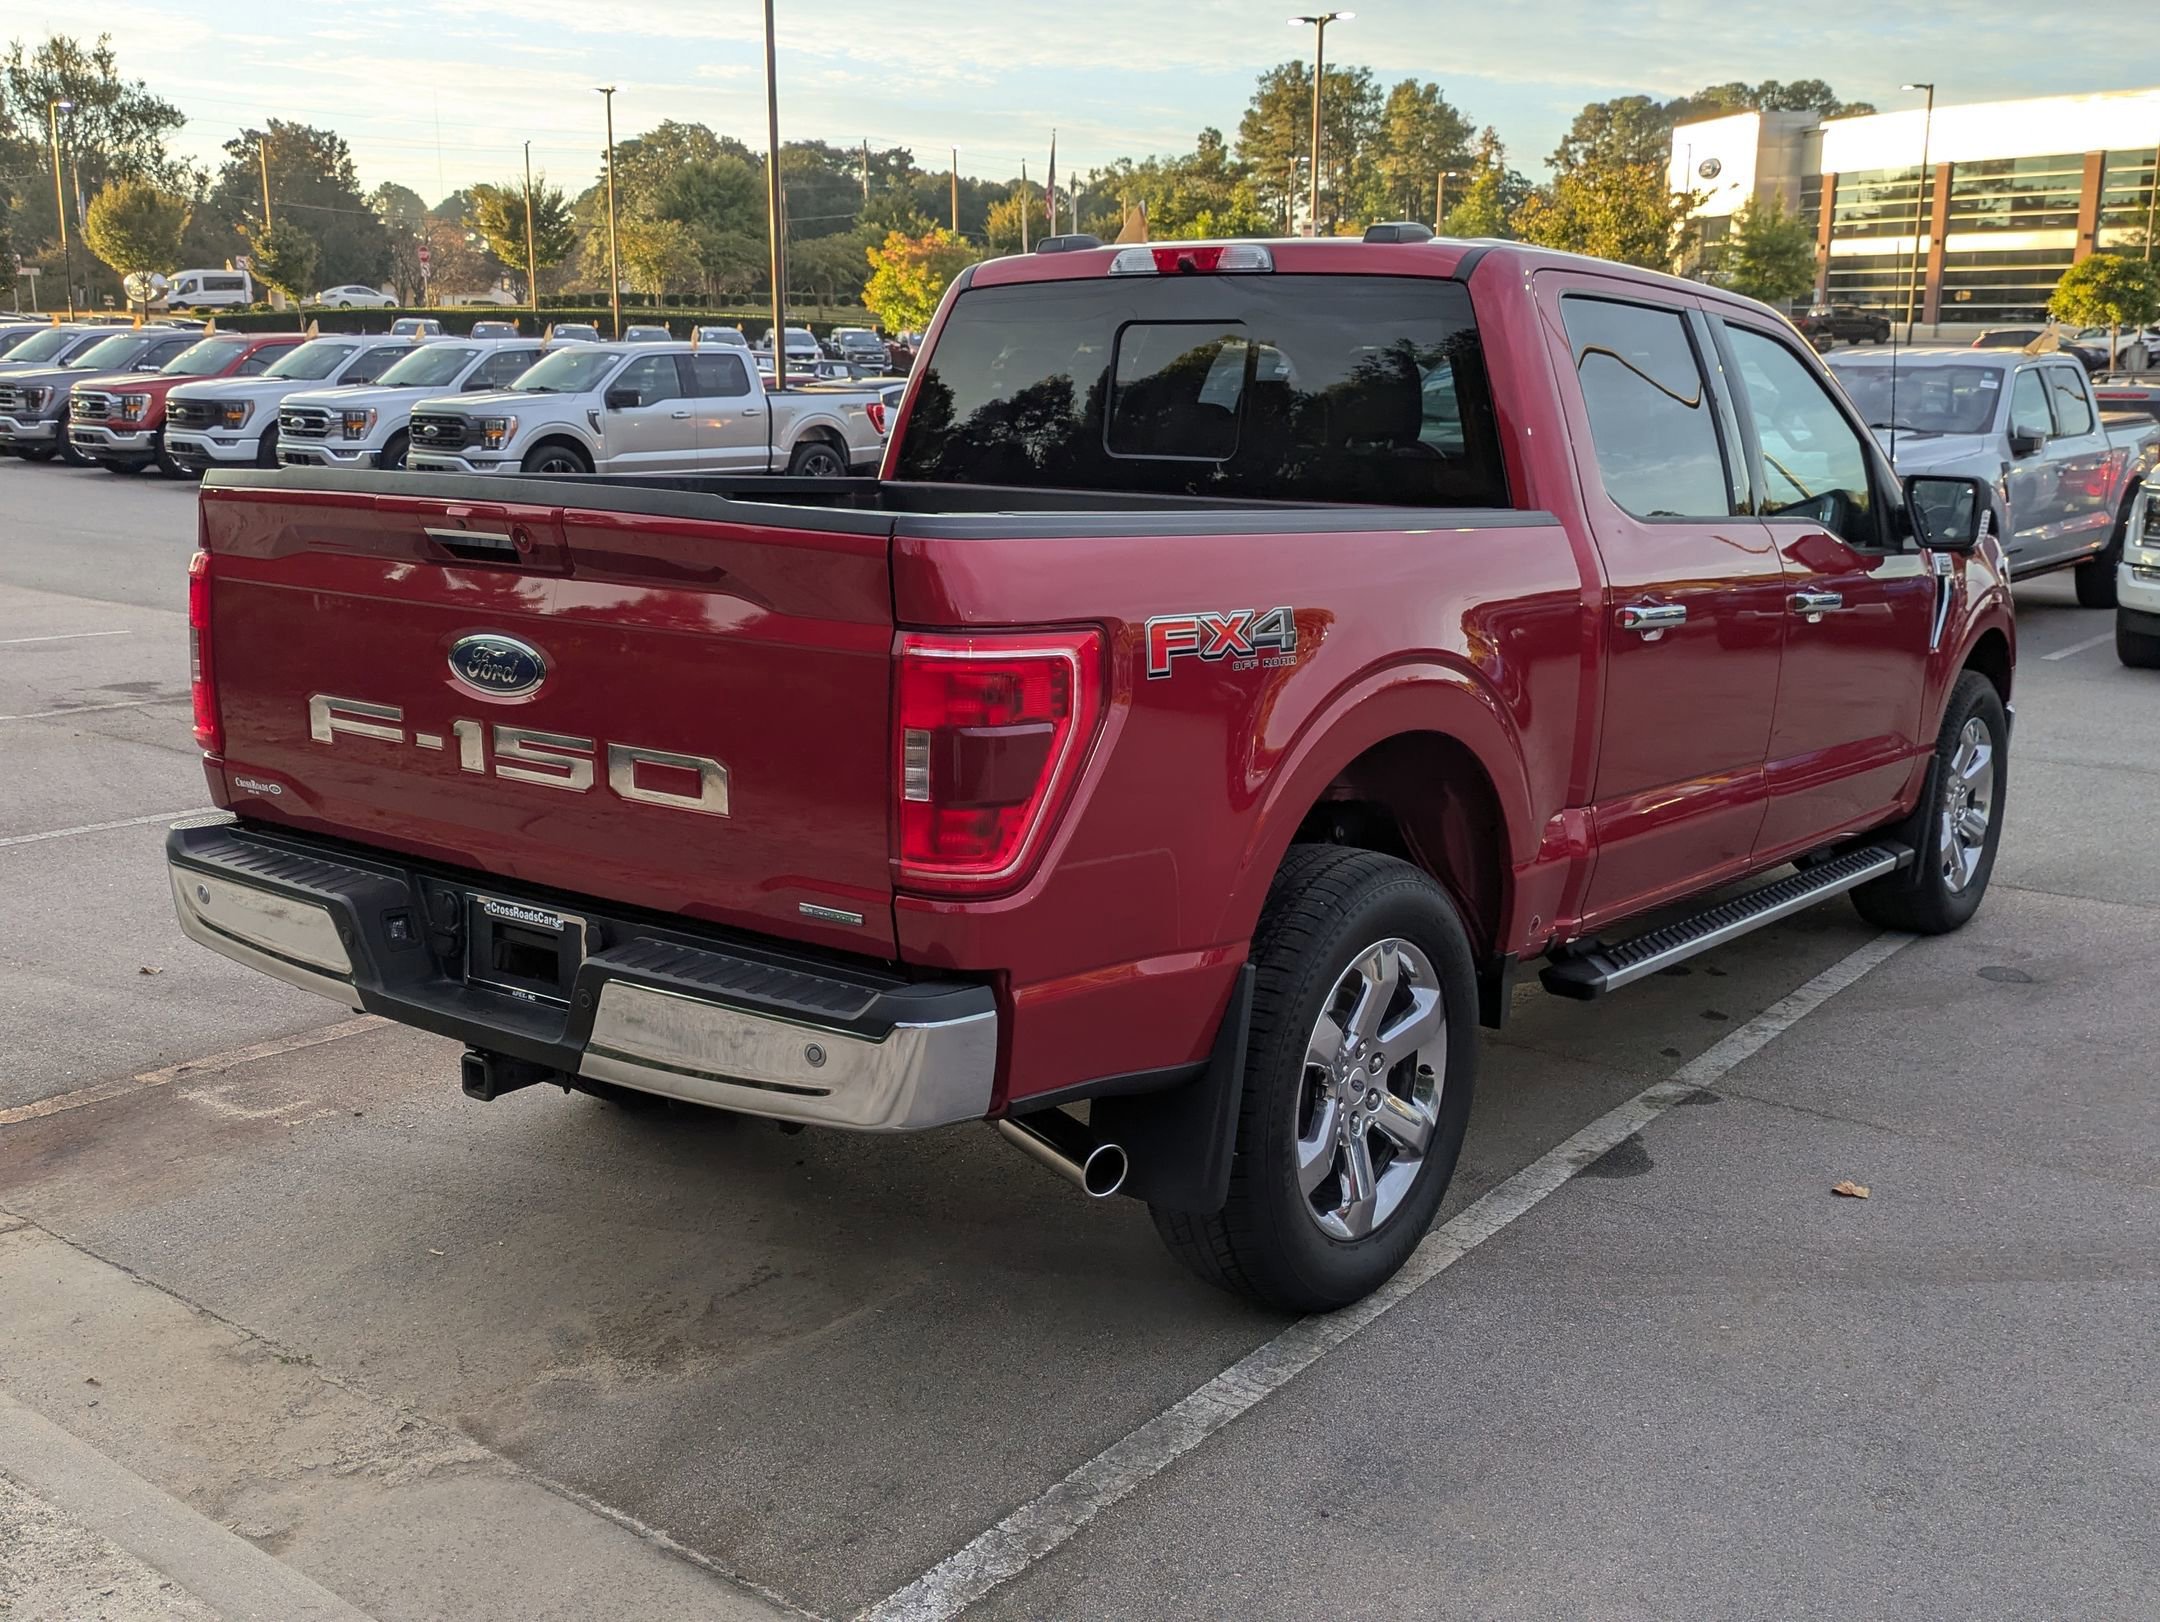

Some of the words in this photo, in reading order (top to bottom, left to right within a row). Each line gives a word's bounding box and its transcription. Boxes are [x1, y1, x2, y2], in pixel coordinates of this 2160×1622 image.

[466, 645, 519, 684] Ford
[1145, 606, 1297, 680] FX4
[1233, 659, 1258, 671] OFF
[309, 694, 731, 818] F-150
